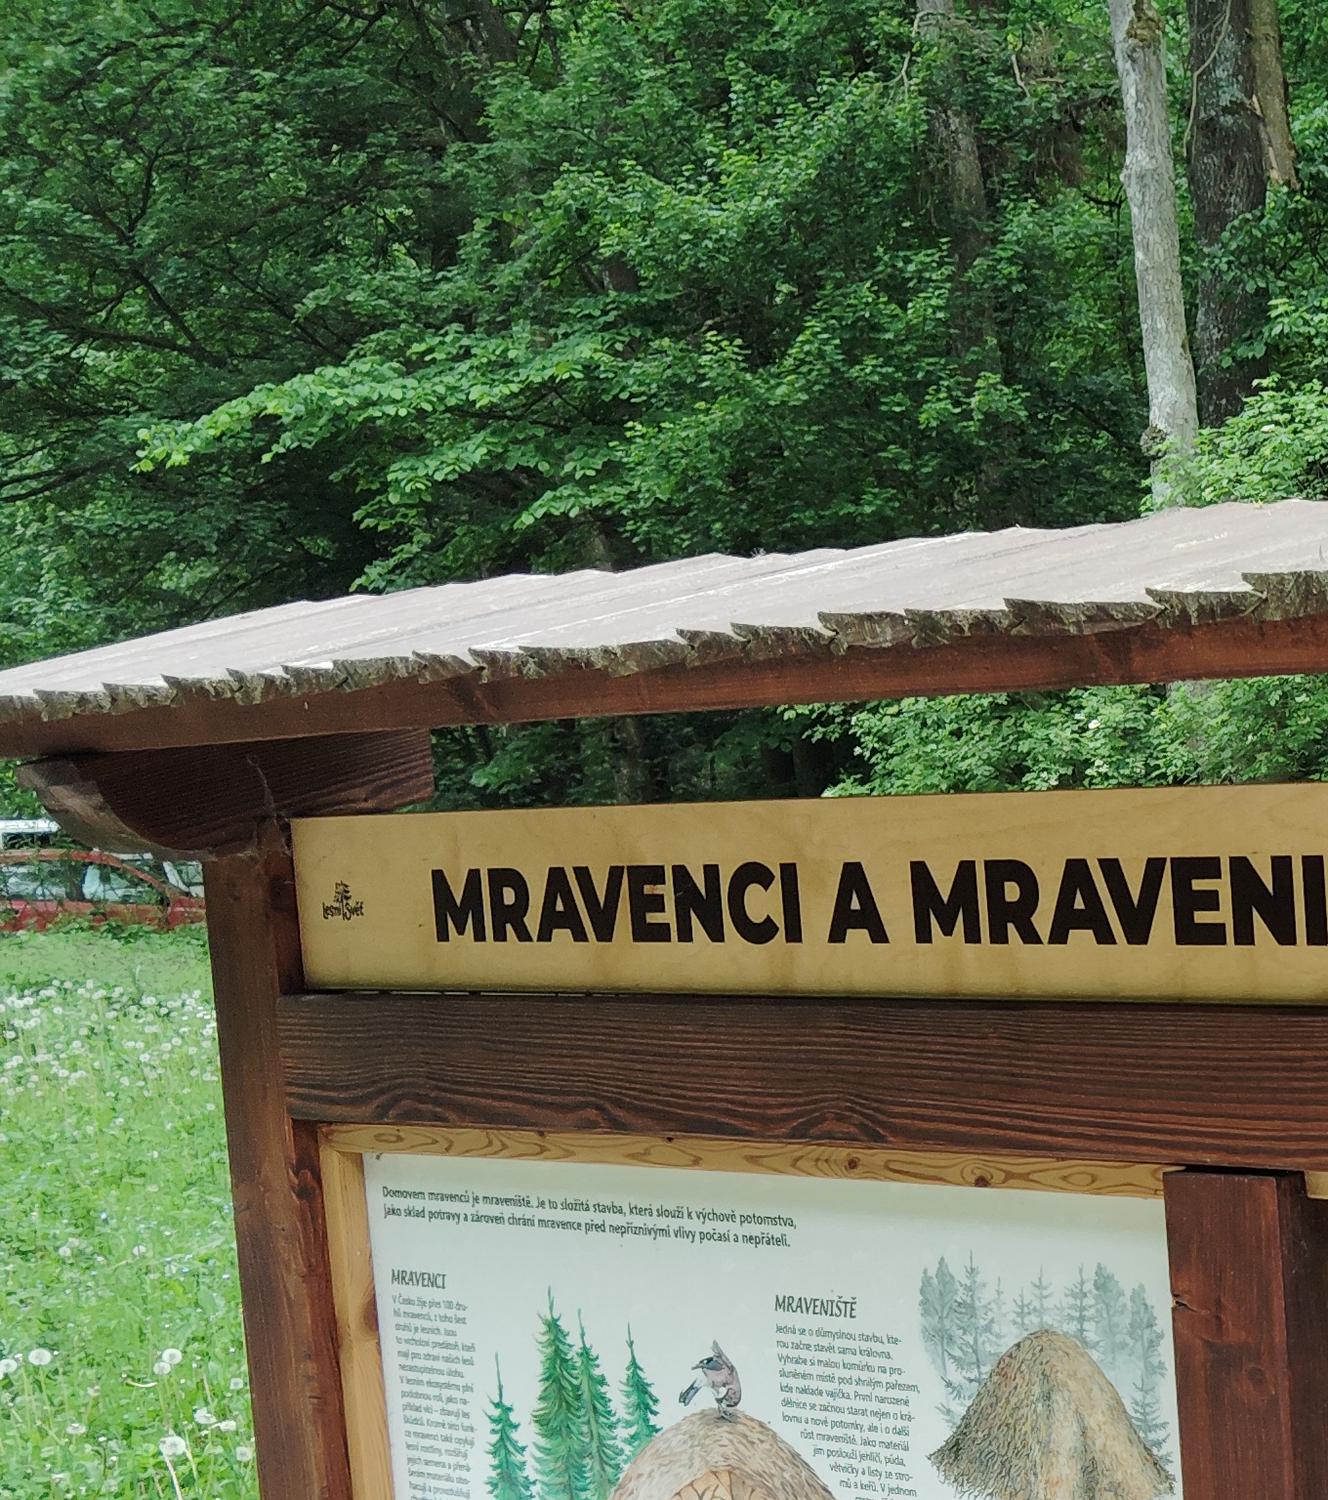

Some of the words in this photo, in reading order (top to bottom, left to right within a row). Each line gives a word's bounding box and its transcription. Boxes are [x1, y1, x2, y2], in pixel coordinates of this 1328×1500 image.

[431, 861, 802, 944] MRAVENCI
[828, 862, 890, 943] A
[382, 1185, 425, 1200] Domovem
[427, 1191, 470, 1203] mravenců
[471, 1192, 480, 1206] je
[481, 1195, 533, 1208] mraveniště.
[535, 1196, 546, 1209] Je
[547, 1197, 558, 1210] to
[559, 1198, 590, 1213] složitá
[592, 1200, 626, 1216] stavba,
[628, 1202, 653, 1217] která
[655, 1205, 684, 1220] slouží
[694, 1207, 736, 1224] výchově
[738, 1211, 797, 1229] potomstva,
[383, 1204, 402, 1219] jako
[403, 1206, 425, 1219] sklad
[427, 1208, 461, 1225] potravy
[470, 1211, 505, 1225] zároveň
[507, 1213, 535, 1228] chrání
[537, 1219, 582, 1231] mravence
[583, 1219, 606, 1235] před
[608, 1222, 671, 1241] nepříznivými
[672, 1225, 696, 1244] vlivy
[698, 1228, 730, 1244] počasí
[741, 1231, 791, 1249] nepřáteli.
[391, 1268, 447, 1289] MRAVENCI
[775, 1294, 857, 1318] MRAVENIŠTĚ
